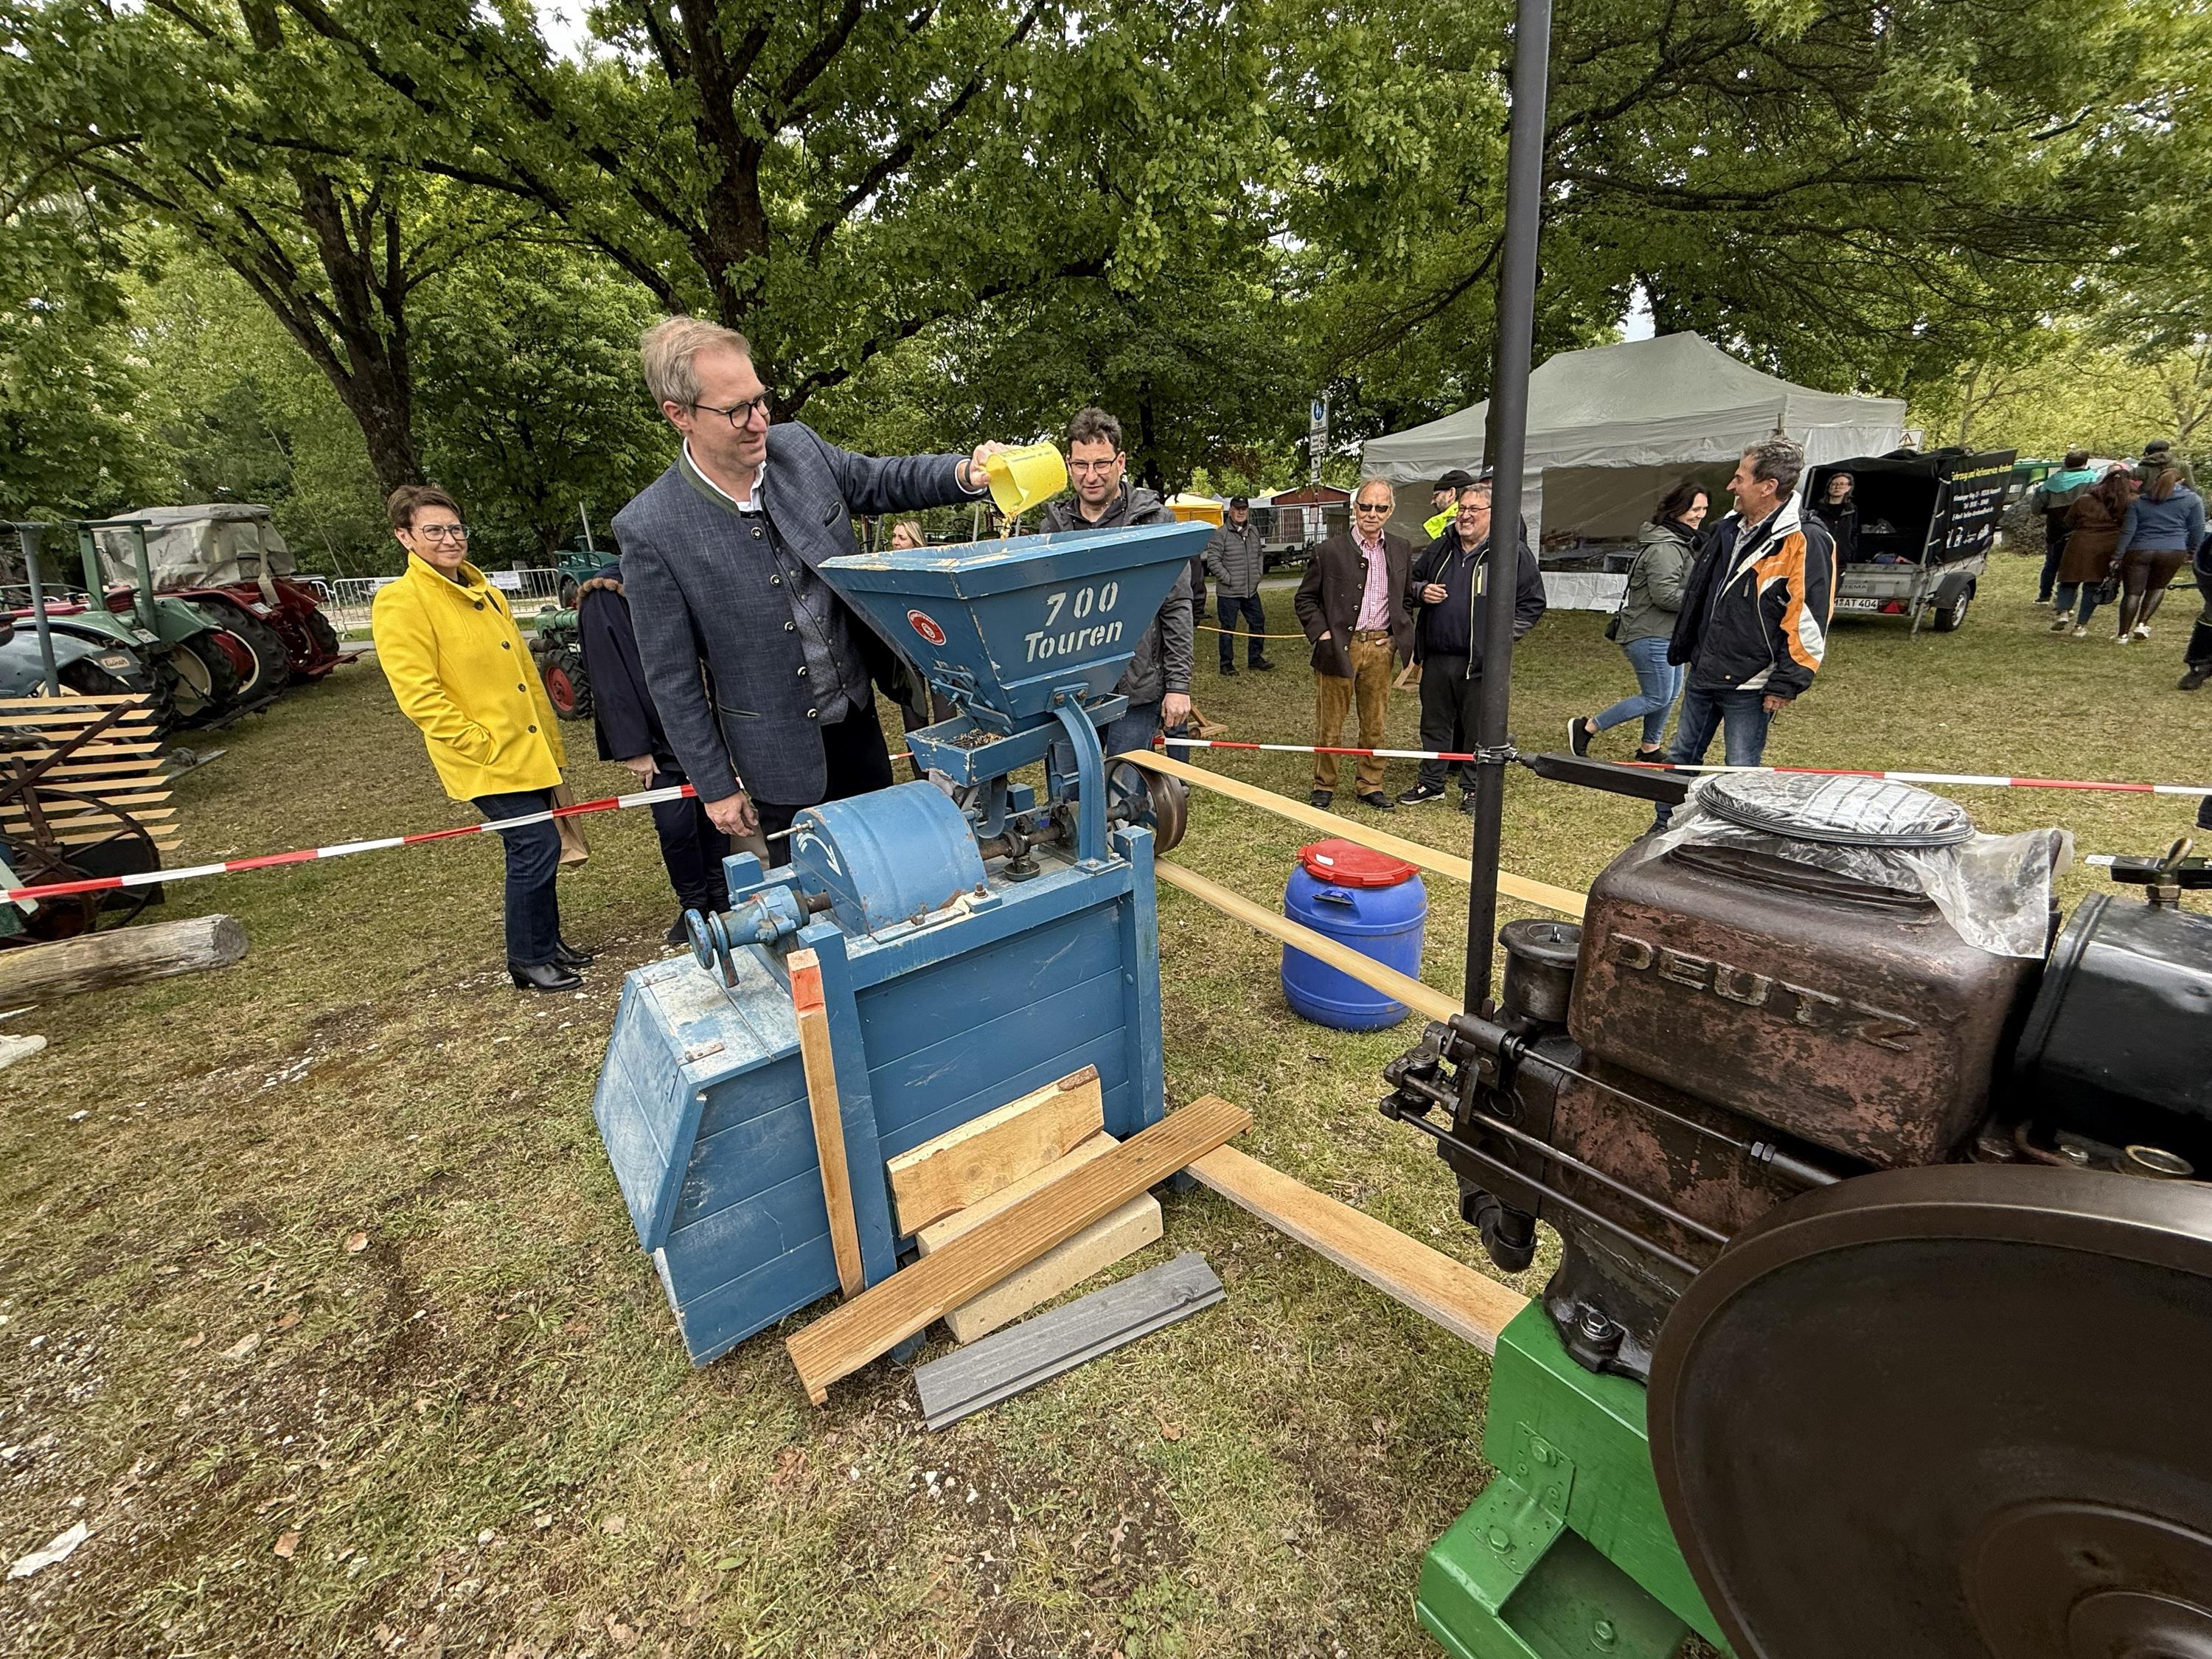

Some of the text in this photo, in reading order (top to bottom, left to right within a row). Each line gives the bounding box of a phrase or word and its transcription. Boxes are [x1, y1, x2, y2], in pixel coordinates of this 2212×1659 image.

[1045, 582, 1119, 627] 700
[1844, 599, 1857, 607] AT
[1859, 599, 1877, 608] 404
[1024, 621, 1123, 663] Touren
[1610, 932, 1919, 1053] DEUTZ
